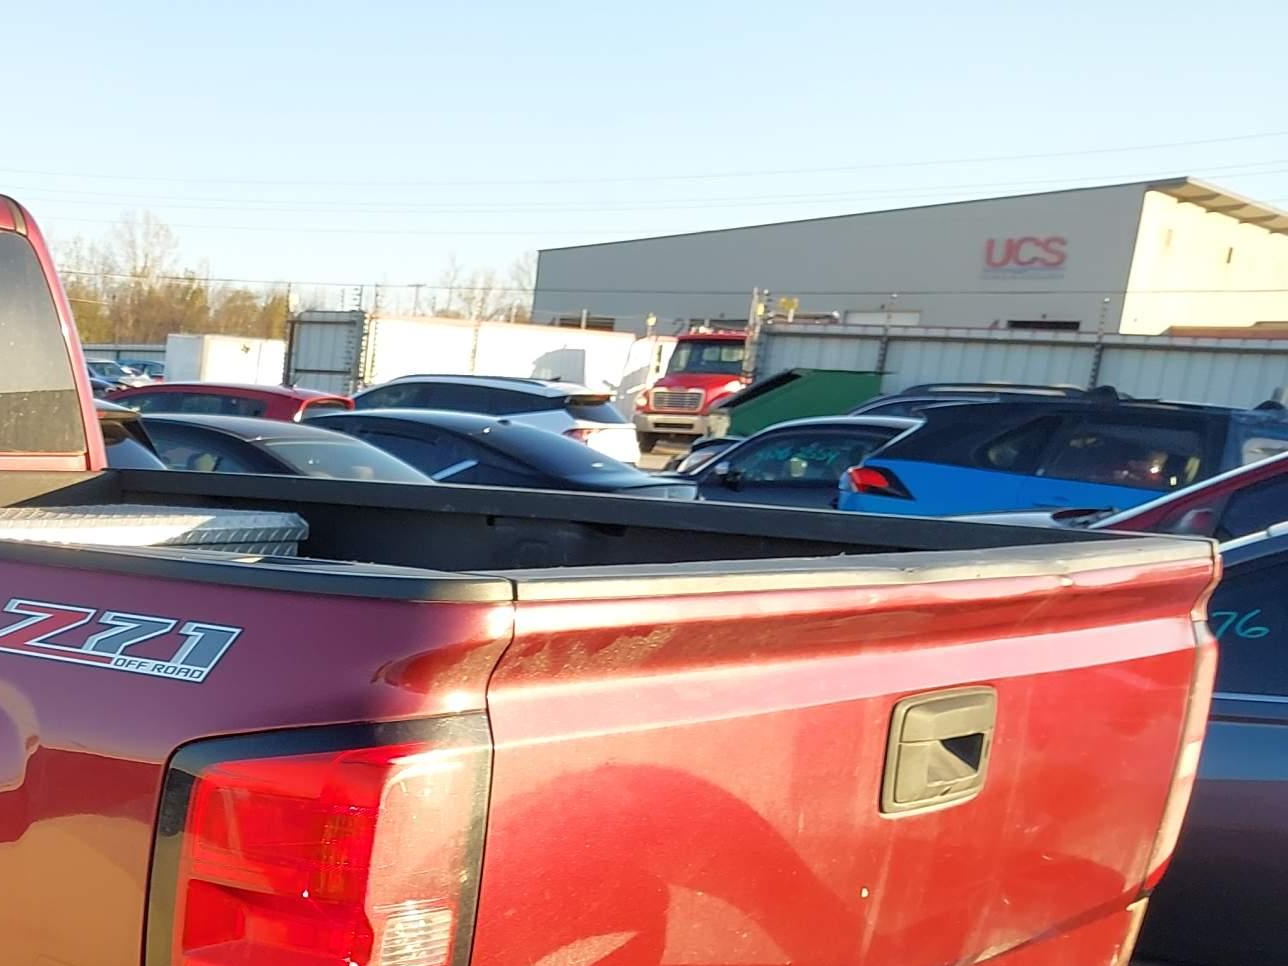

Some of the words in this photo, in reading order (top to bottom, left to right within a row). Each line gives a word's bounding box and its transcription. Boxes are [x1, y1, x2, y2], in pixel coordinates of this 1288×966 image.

[984, 236, 1066, 268] UCS
[113, 657, 150, 670] OFF
[152, 663, 205, 679] ROAD
